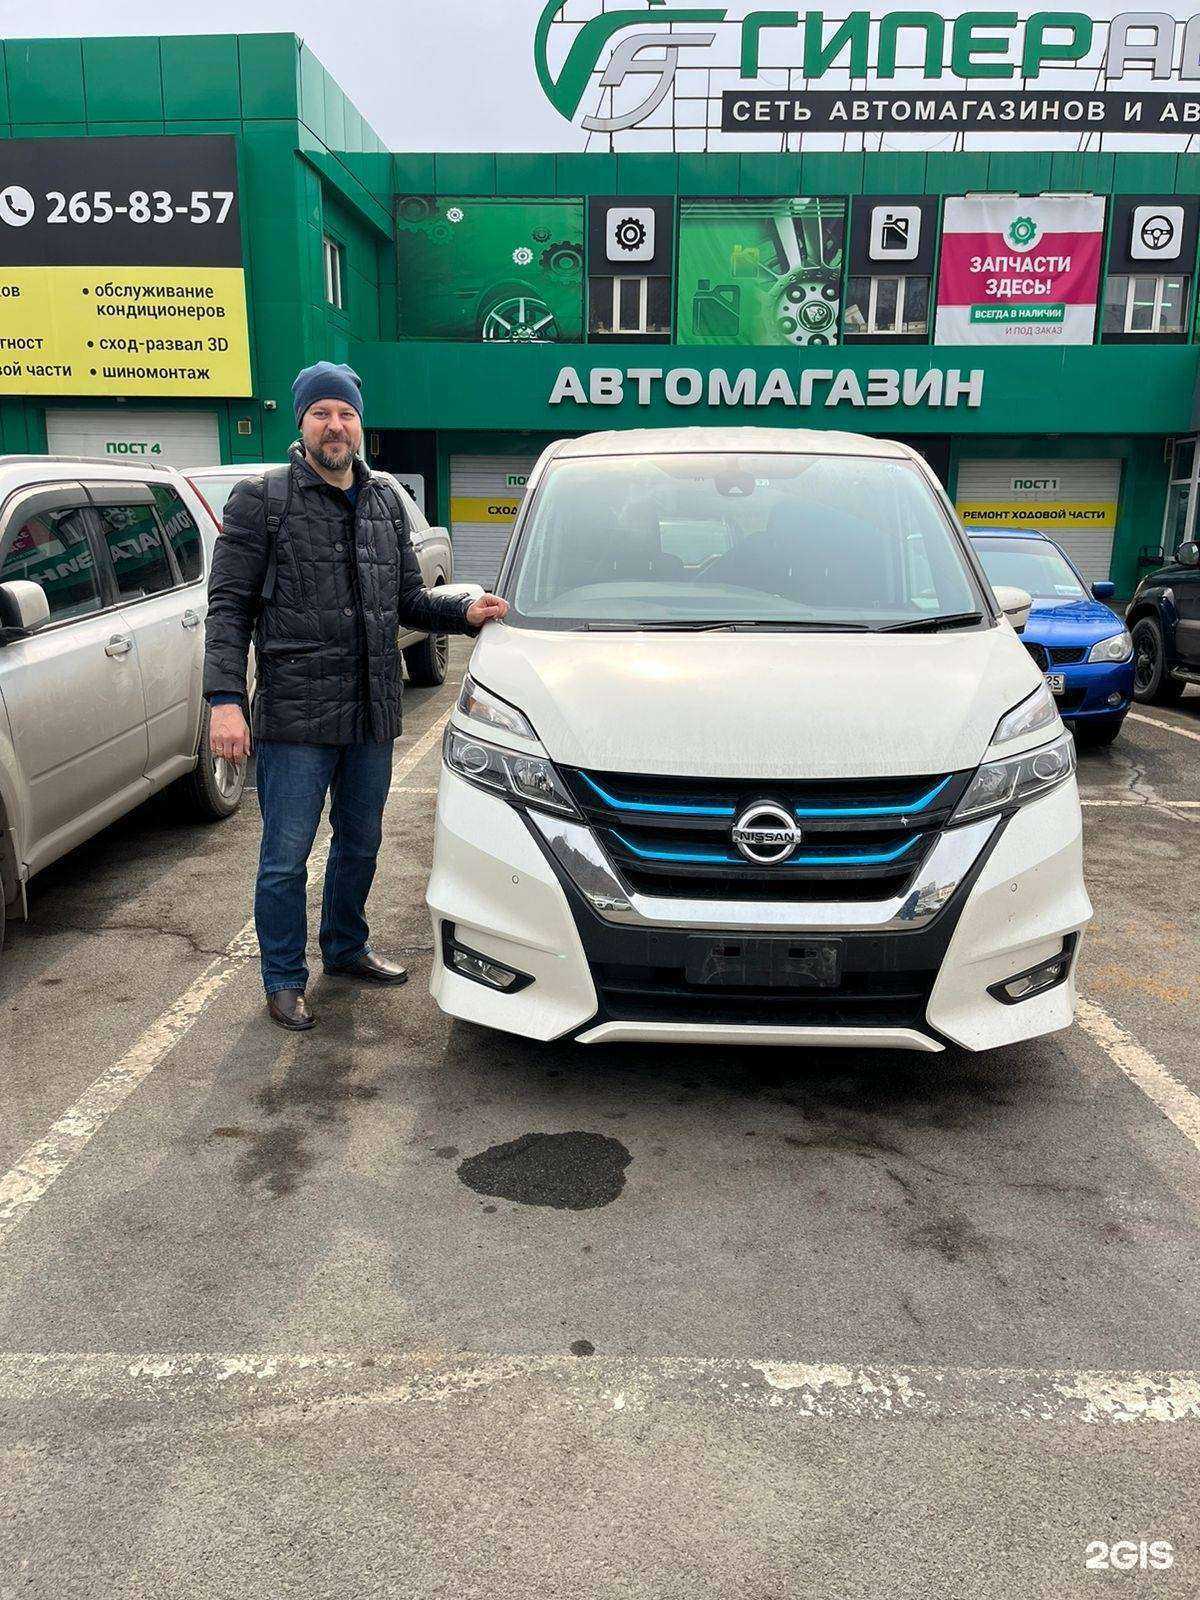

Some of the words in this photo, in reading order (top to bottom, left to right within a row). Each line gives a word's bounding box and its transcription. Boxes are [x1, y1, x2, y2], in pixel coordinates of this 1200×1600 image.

[740, 10, 1200, 81] ГИПЕРА
[732, 99, 812, 121] СЕТЬ
[829, 99, 1106, 121] АВТОМАГАЗИНОВ
[1123, 101, 1143, 122] И
[45, 190, 234, 224] 265-83-57
[970, 256, 1072, 273] ЗАПЧАСТИ
[0, 286, 20, 297] ов
[95, 282, 214, 300] обслуживание
[985, 278, 1052, 298] ЗДЕСЬ!
[97, 303, 226, 320] кондиционеров
[974, 309, 1009, 320] ВСЕГДА
[1010, 310, 1017, 319] В
[1019, 308, 1063, 319] НАЛИЧИИ
[1005, 327, 1012, 335] И
[1013, 327, 1033, 336] ПОД
[1035, 326, 1063, 336] ЗАКАЗ
[100, 338, 203, 354] сход-развал
[208, 337, 229, 352] 3D
[0, 361, 22, 376] ой
[26, 364, 72, 377] части
[103, 366, 210, 380] шиномонтаж
[547, 366, 986, 408] АВТОМАГАЗИН
[106, 442, 149, 455] ПОСТ
[150, 442, 162, 455] 4
[507, 475, 528, 487] ПО
[1013, 479, 1049, 490] ПОСТ
[1050, 479, 1057, 489] 1
[963, 510, 1010, 520] РЕМОНТ
[1012, 508, 1067, 520] ХОДОВОЙ
[1068, 510, 1106, 520] ЧАСТИ
[739, 832, 795, 842] NISSAN
